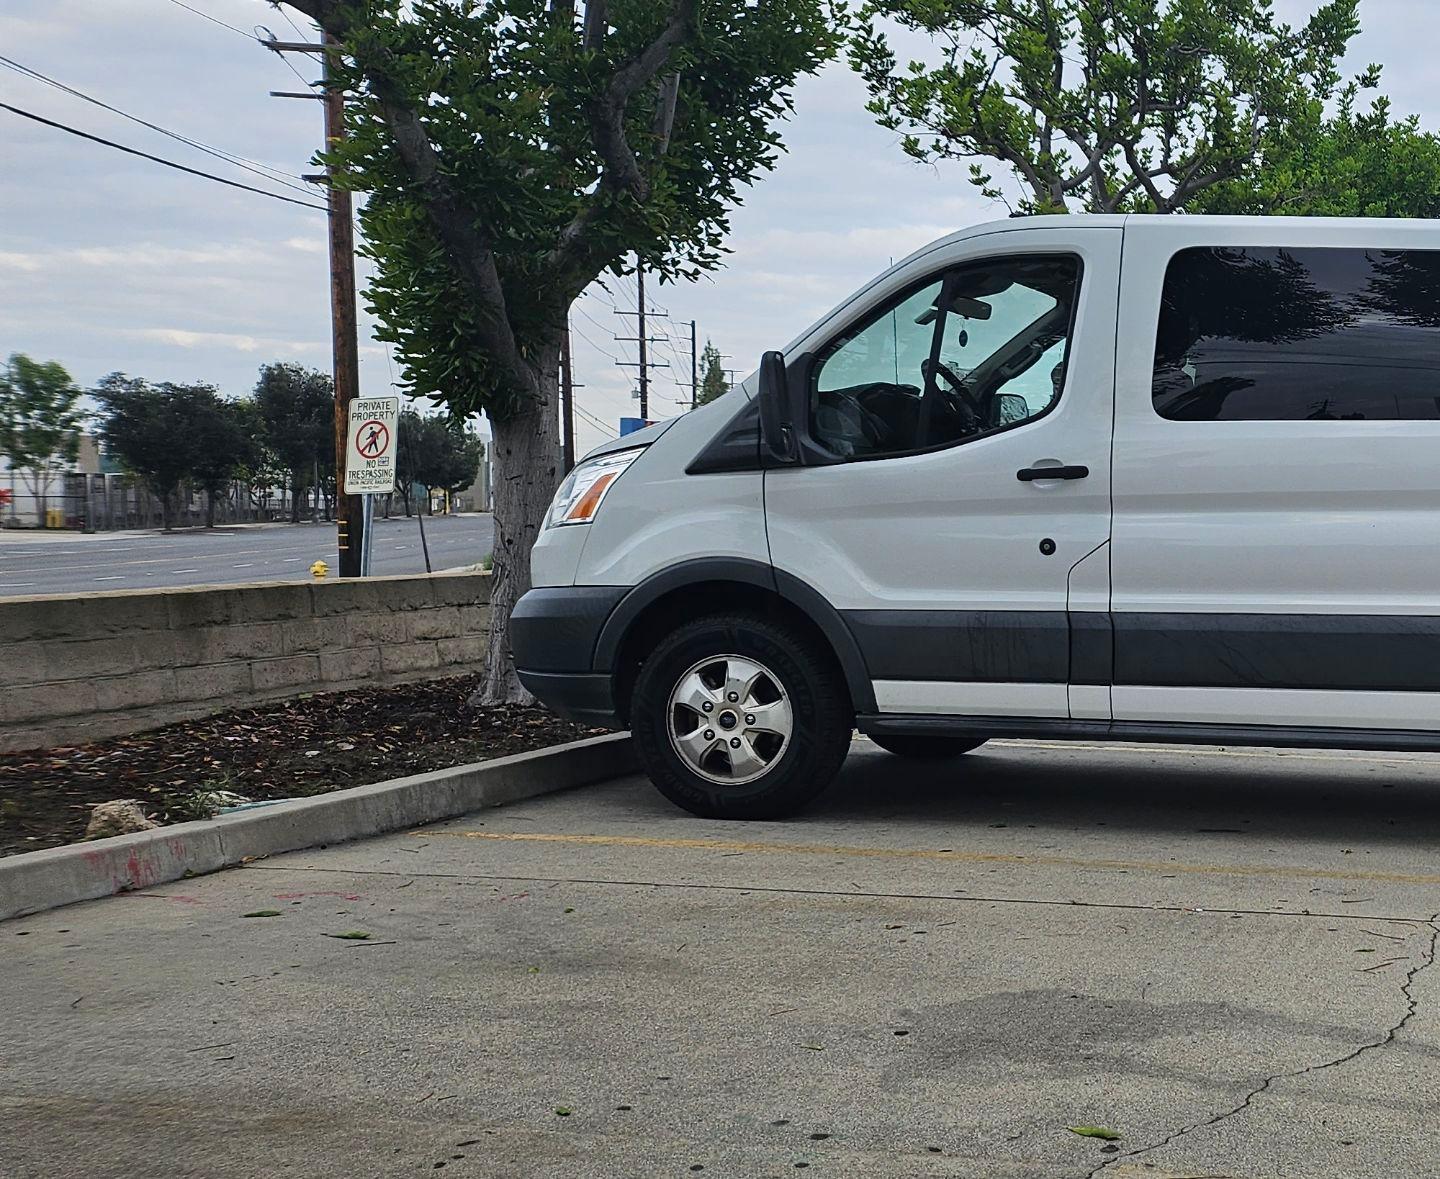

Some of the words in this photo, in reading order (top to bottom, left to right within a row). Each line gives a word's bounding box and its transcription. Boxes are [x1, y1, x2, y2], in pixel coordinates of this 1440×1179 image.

[357, 401, 391, 411] PRIVATE
[351, 410, 395, 421] PROPERTY
[366, 459, 377, 468] NO
[348, 469, 393, 479] TRESPASSING
